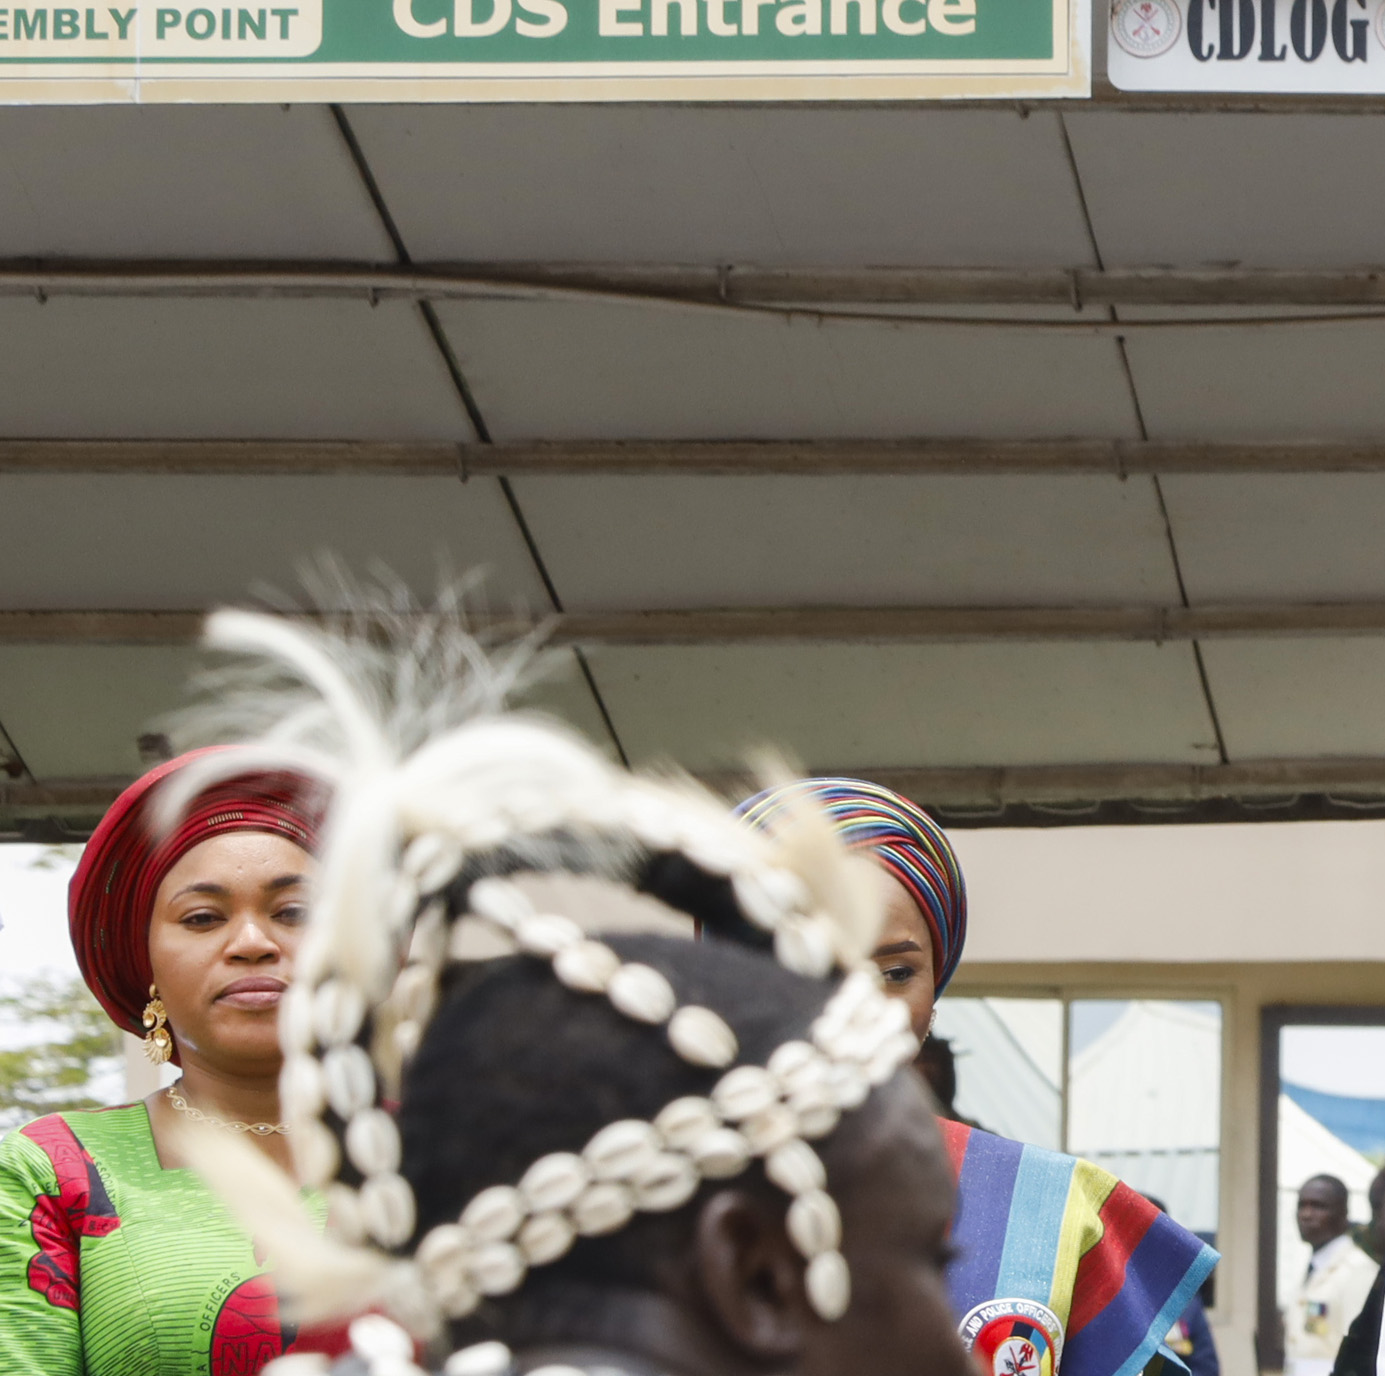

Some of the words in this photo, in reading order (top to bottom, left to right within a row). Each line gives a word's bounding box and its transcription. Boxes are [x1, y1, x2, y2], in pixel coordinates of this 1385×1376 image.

[155, 8, 299, 41] POINT
[392, 0, 568, 38] CDS
[598, 0, 977, 37] Entrance
[1187, 0, 1369, 63] CDLOG
[199, 1271, 241, 1332] OFFICERS
[979, 1302, 1014, 1322] POLICE
[1016, 1302, 1058, 1333] OFFICERS
